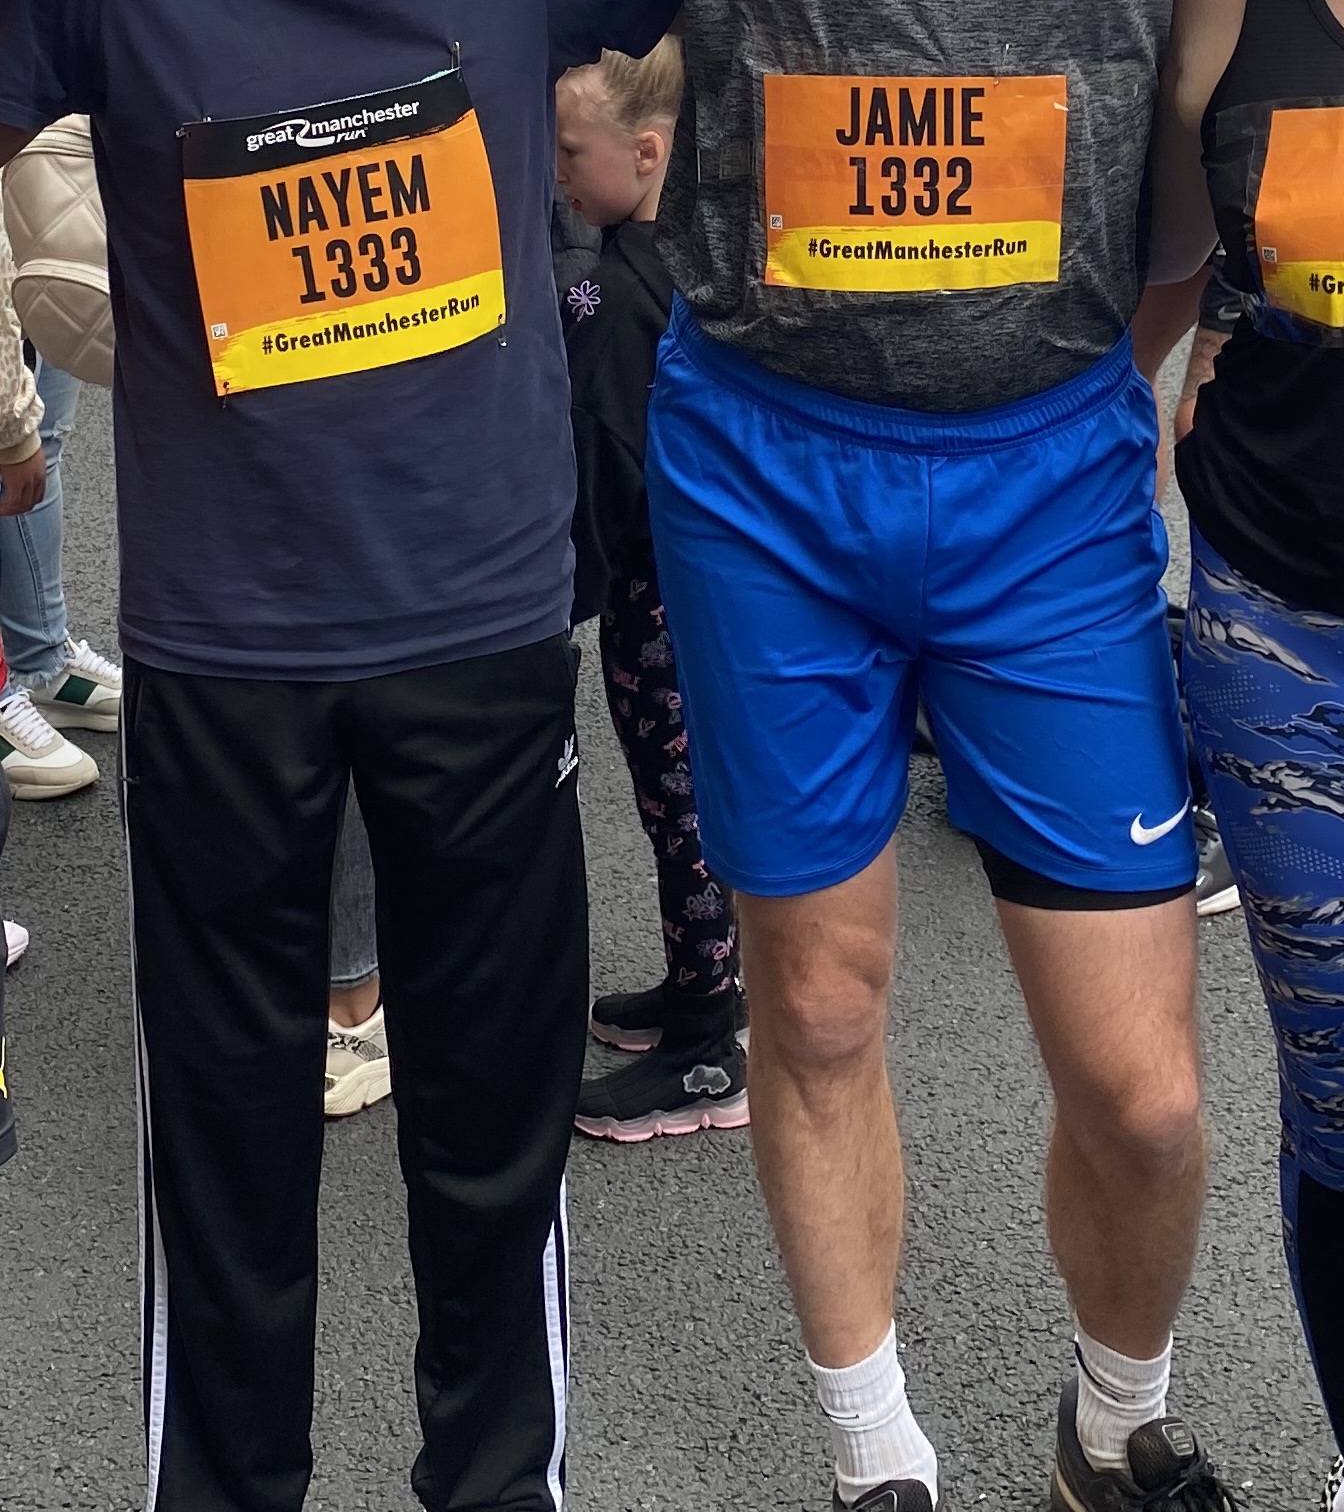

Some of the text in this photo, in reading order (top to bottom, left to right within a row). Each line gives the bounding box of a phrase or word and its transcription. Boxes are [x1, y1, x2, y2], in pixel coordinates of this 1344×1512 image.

[246, 101, 420, 152] great manchester
[335, 127, 367, 144] run
[835, 87, 985, 146] JAMIE
[259, 153, 431, 242] NAYEM
[848, 156, 973, 217] 1332
[291, 226, 423, 305] 1333
[807, 238, 1028, 261] #GreatManchesterRun
[262, 293, 480, 356] #GreatManchesterRun
